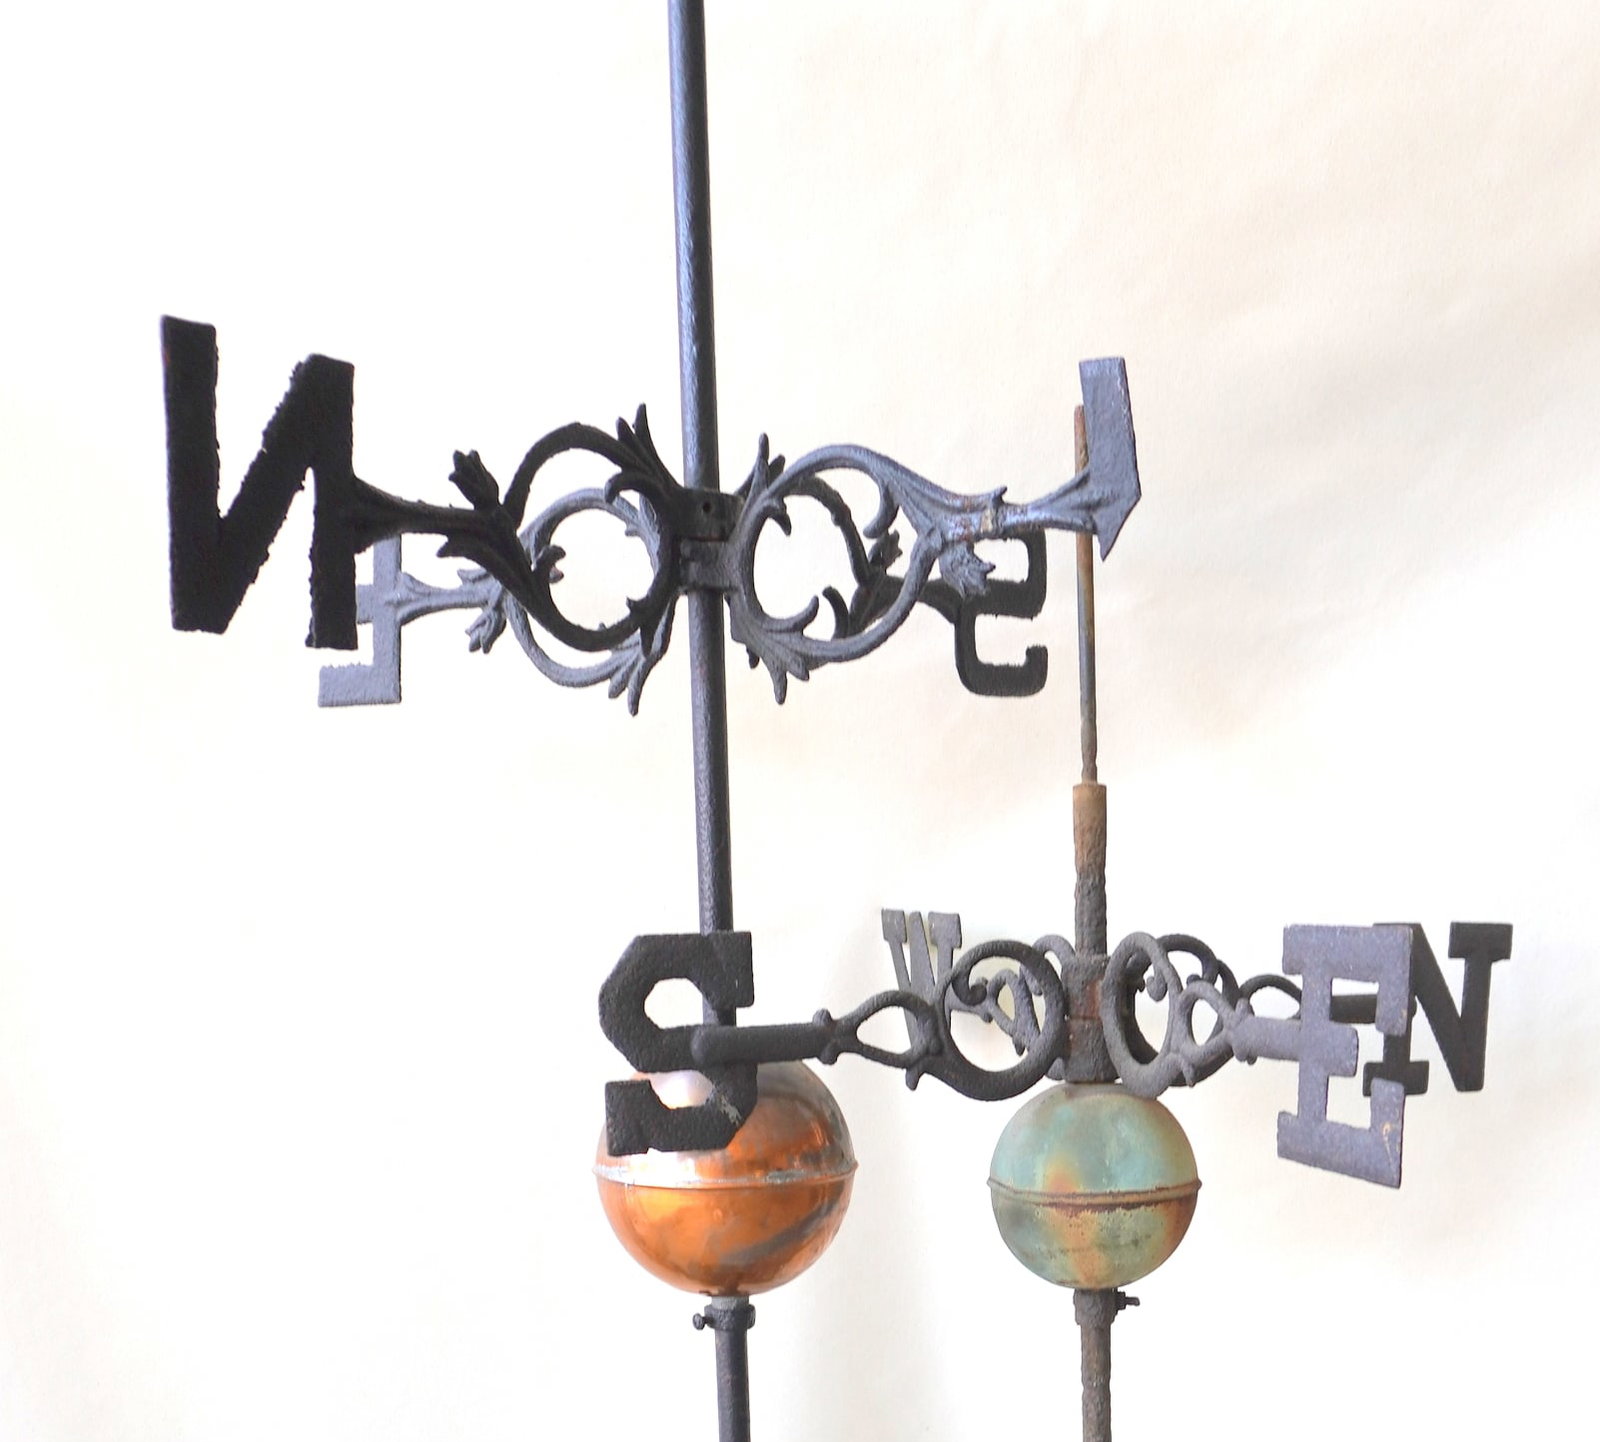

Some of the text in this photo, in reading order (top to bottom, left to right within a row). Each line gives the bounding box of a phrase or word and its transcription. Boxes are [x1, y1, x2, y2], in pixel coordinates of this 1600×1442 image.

[598, 930, 757, 1157] S
[1277, 923, 1413, 1188] E
[1363, 921, 1514, 1092] N
